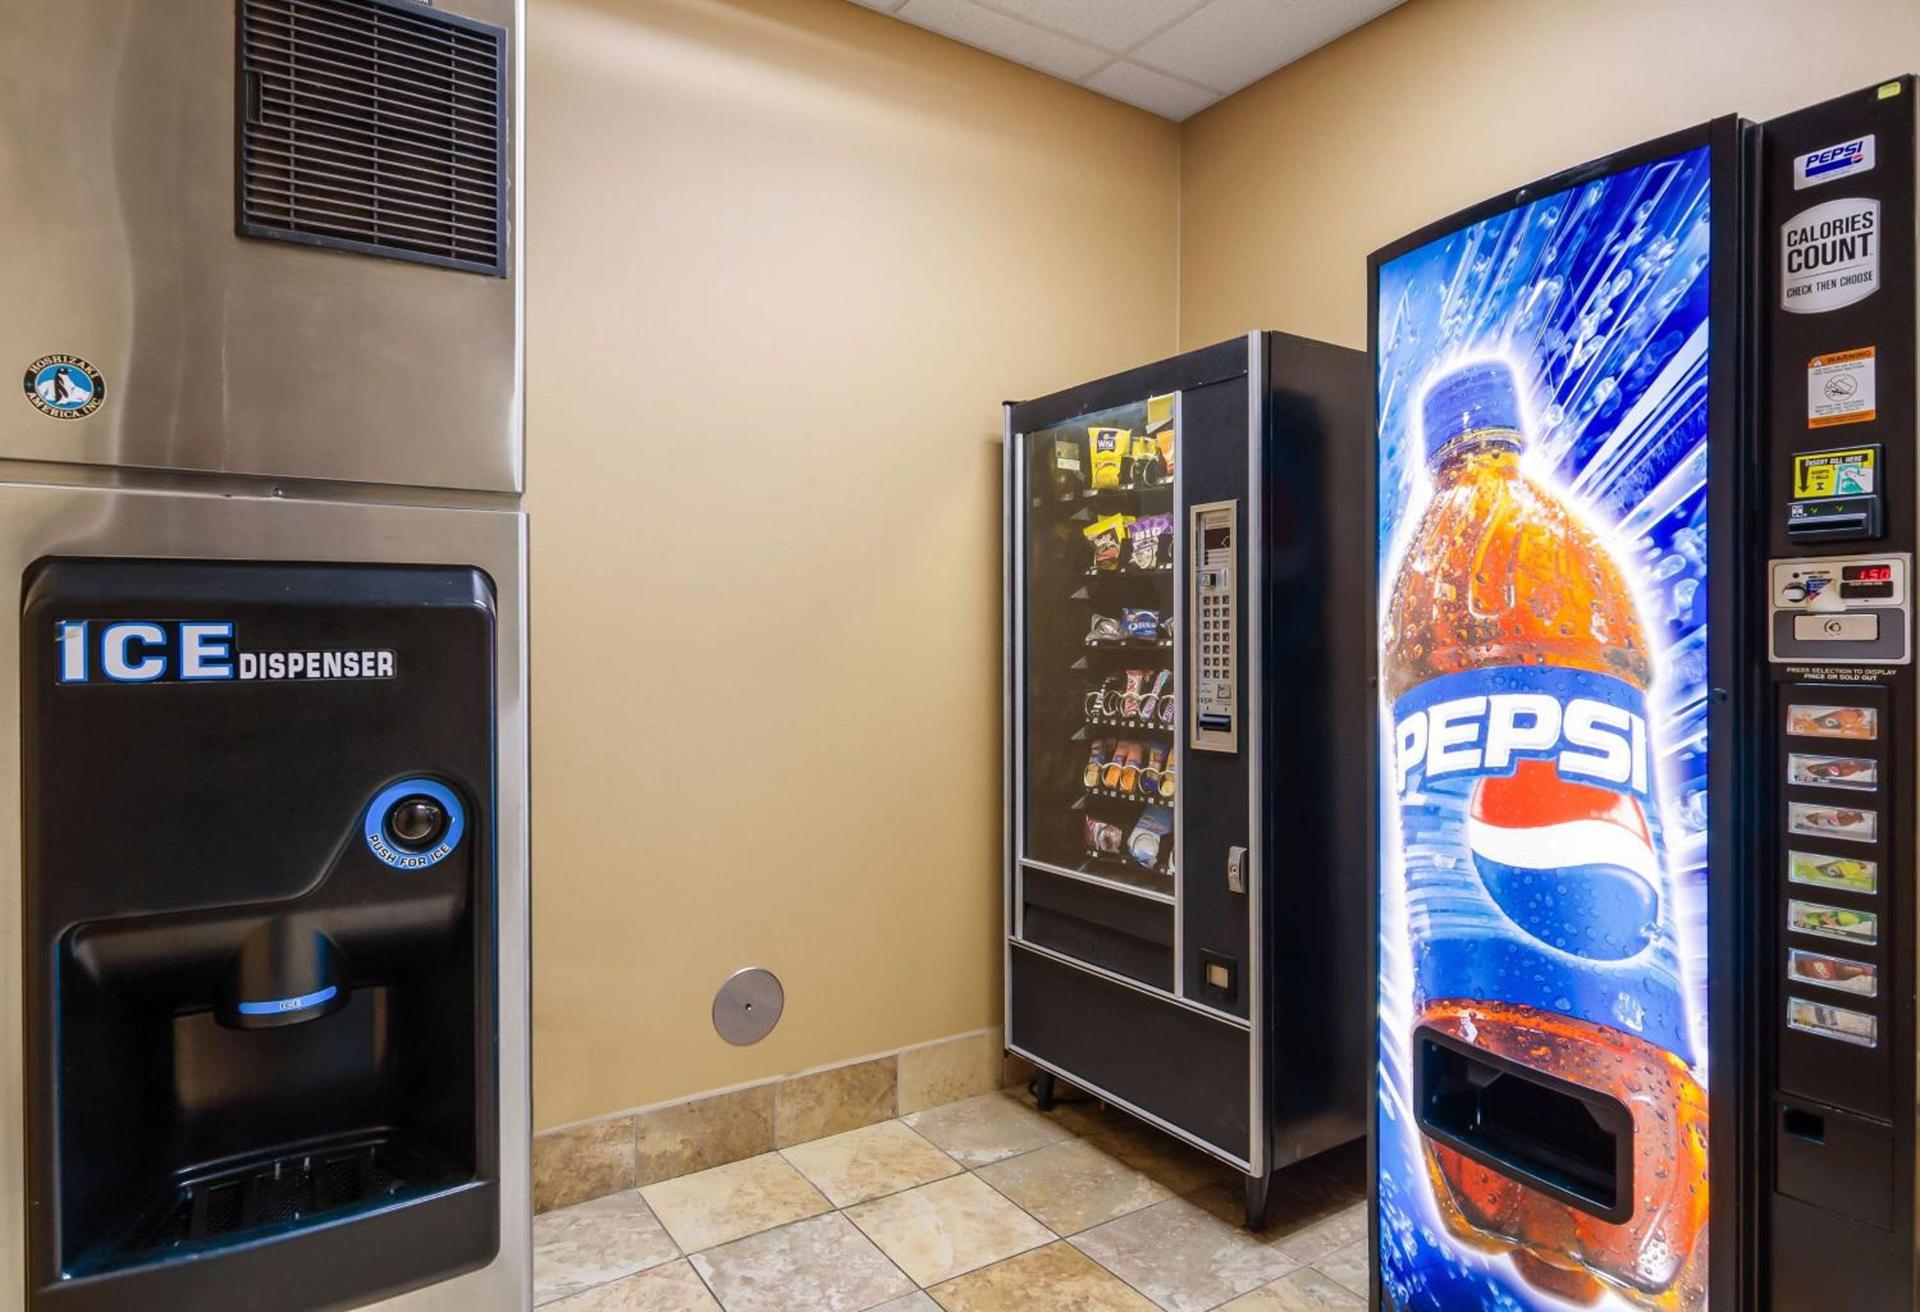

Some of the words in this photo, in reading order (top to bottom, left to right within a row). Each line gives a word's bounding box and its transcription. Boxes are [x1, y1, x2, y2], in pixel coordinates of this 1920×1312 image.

[1806, 140, 1863, 168] PEPSI
[1787, 211, 1873, 247] CALORIES
[1787, 232, 1873, 274] COUNT
[1786, 278, 1813, 298] CHECK
[1816, 275, 1837, 292] THEN
[1840, 271, 1873, 288] CHOOSE
[29, 355, 99, 378] HOSHIZAKI
[61, 620, 233, 682] ICE
[239, 651, 394, 679] DISPENSER
[1395, 693, 1649, 796] PEPSI
[369, 833, 397, 864] PUSH
[400, 857, 426, 868] FOR
[430, 842, 450, 861] ICE
